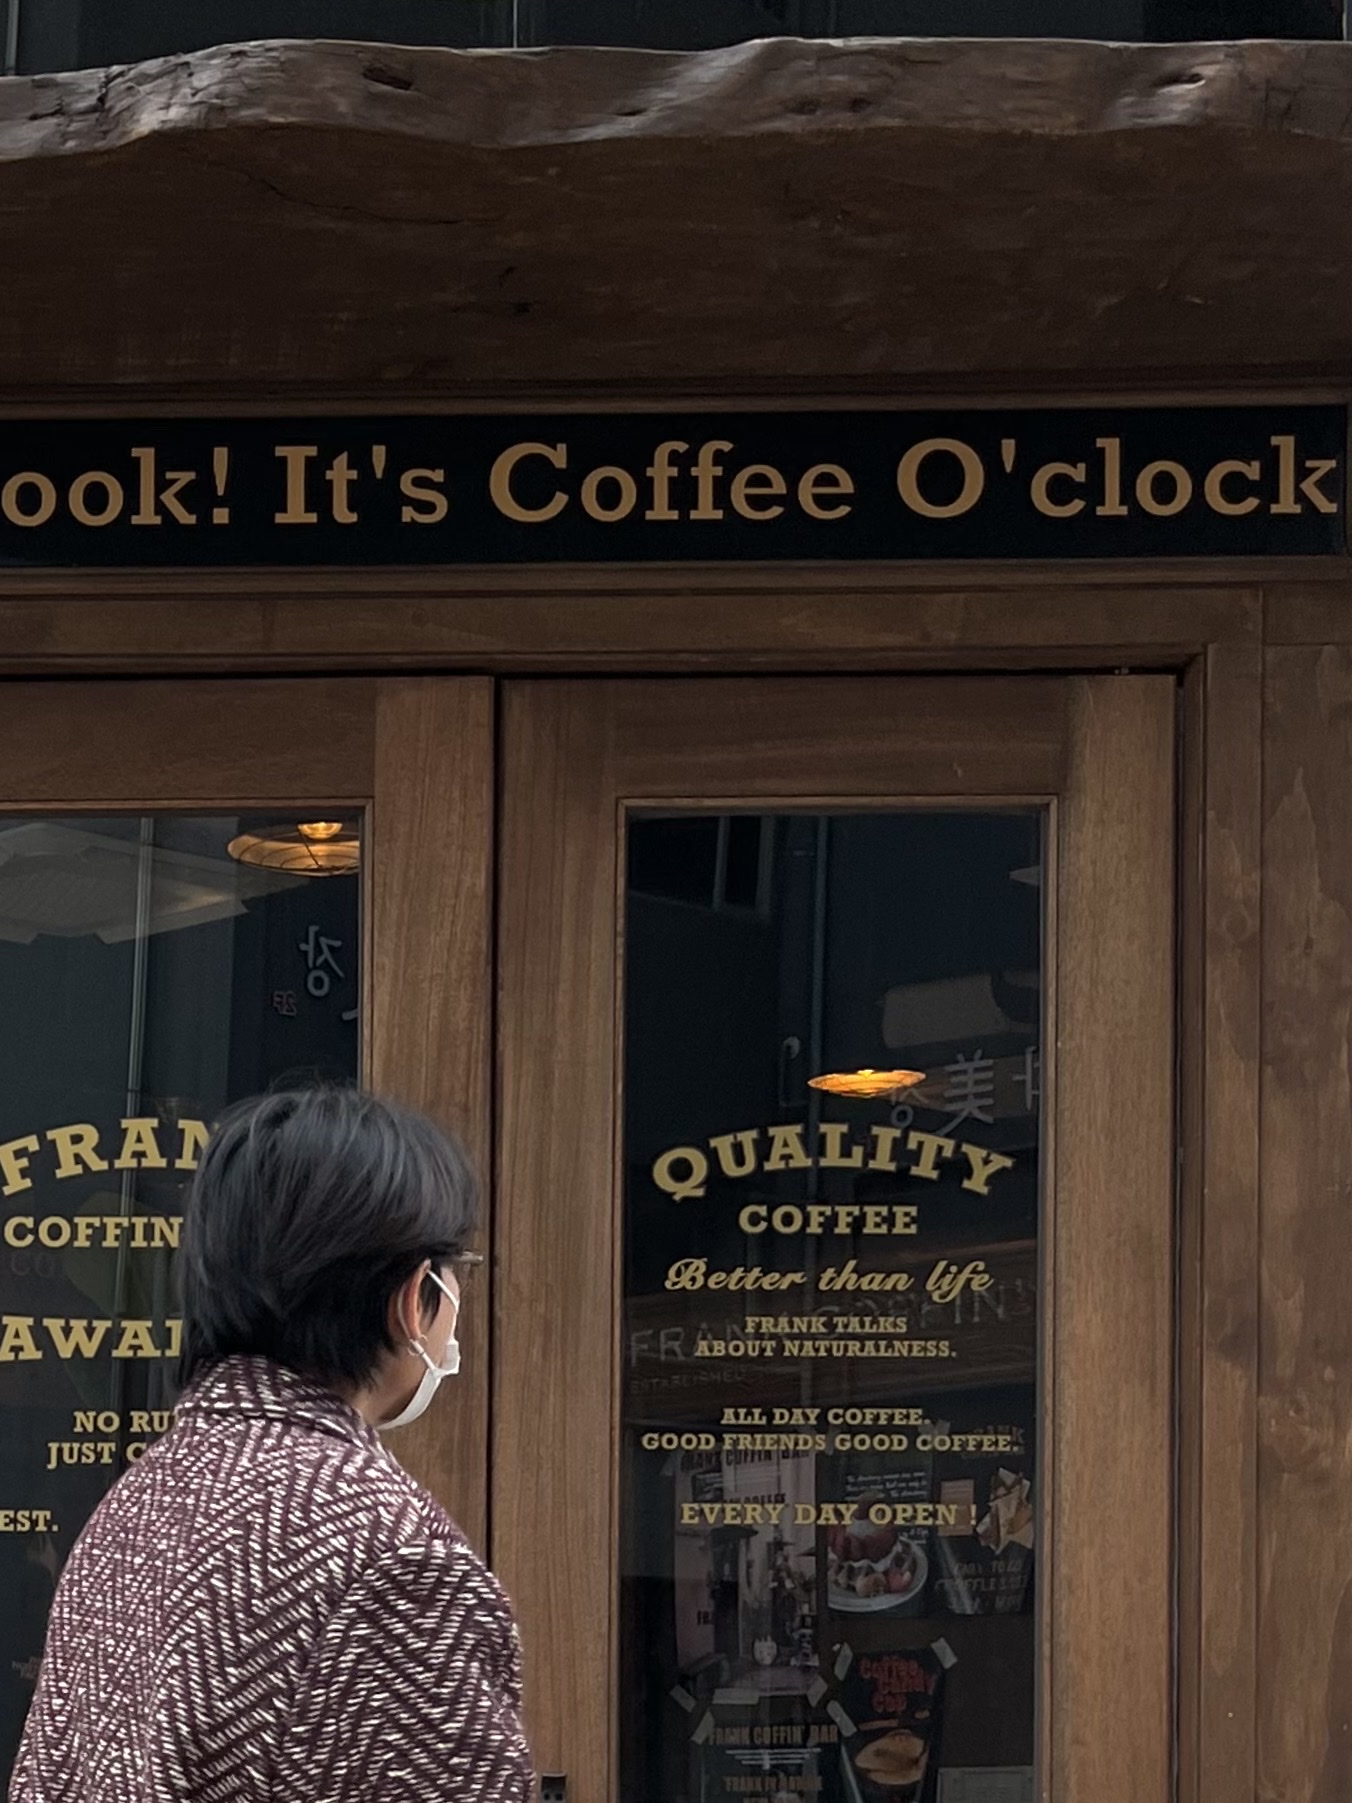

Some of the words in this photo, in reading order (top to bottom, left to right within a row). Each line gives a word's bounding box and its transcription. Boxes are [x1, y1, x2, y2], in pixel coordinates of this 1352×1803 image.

[273, 444, 449, 525] It's
[488, 439, 855, 523] Coffee
[896, 435, 1339, 519] O'clock
[652, 1122, 1016, 1201] QUALITY
[738, 1204, 918, 1235] COFFEE
[663, 1257, 806, 1292] Better
[817, 1259, 914, 1292] than
[924, 1260, 995, 1304] life
[744, 1316, 827, 1334] FRANK
[833, 1316, 908, 1334] TALKS
[694, 1339, 777, 1358] ABOUT
[782, 1339, 957, 1358] NATURALNESS.
[72, 1410, 121, 1433] NO
[128, 1410, 178, 1434] RU
[720, 1408, 767, 1425] ALL
[772, 1408, 821, 1425] DAY
[826, 1408, 931, 1425] COFFEE.
[641, 1433, 716, 1452] GOOD
[722, 1433, 826, 1452] FRIENDS
[834, 1433, 909, 1452] GOOD
[915, 1433, 1020, 1452] COFFEE.
[47, 1441, 117, 1470] JUST
[680, 1502, 786, 1526] EVERY
[793, 1502, 858, 1526] DAY
[868, 1502, 959, 1526] OPEN
